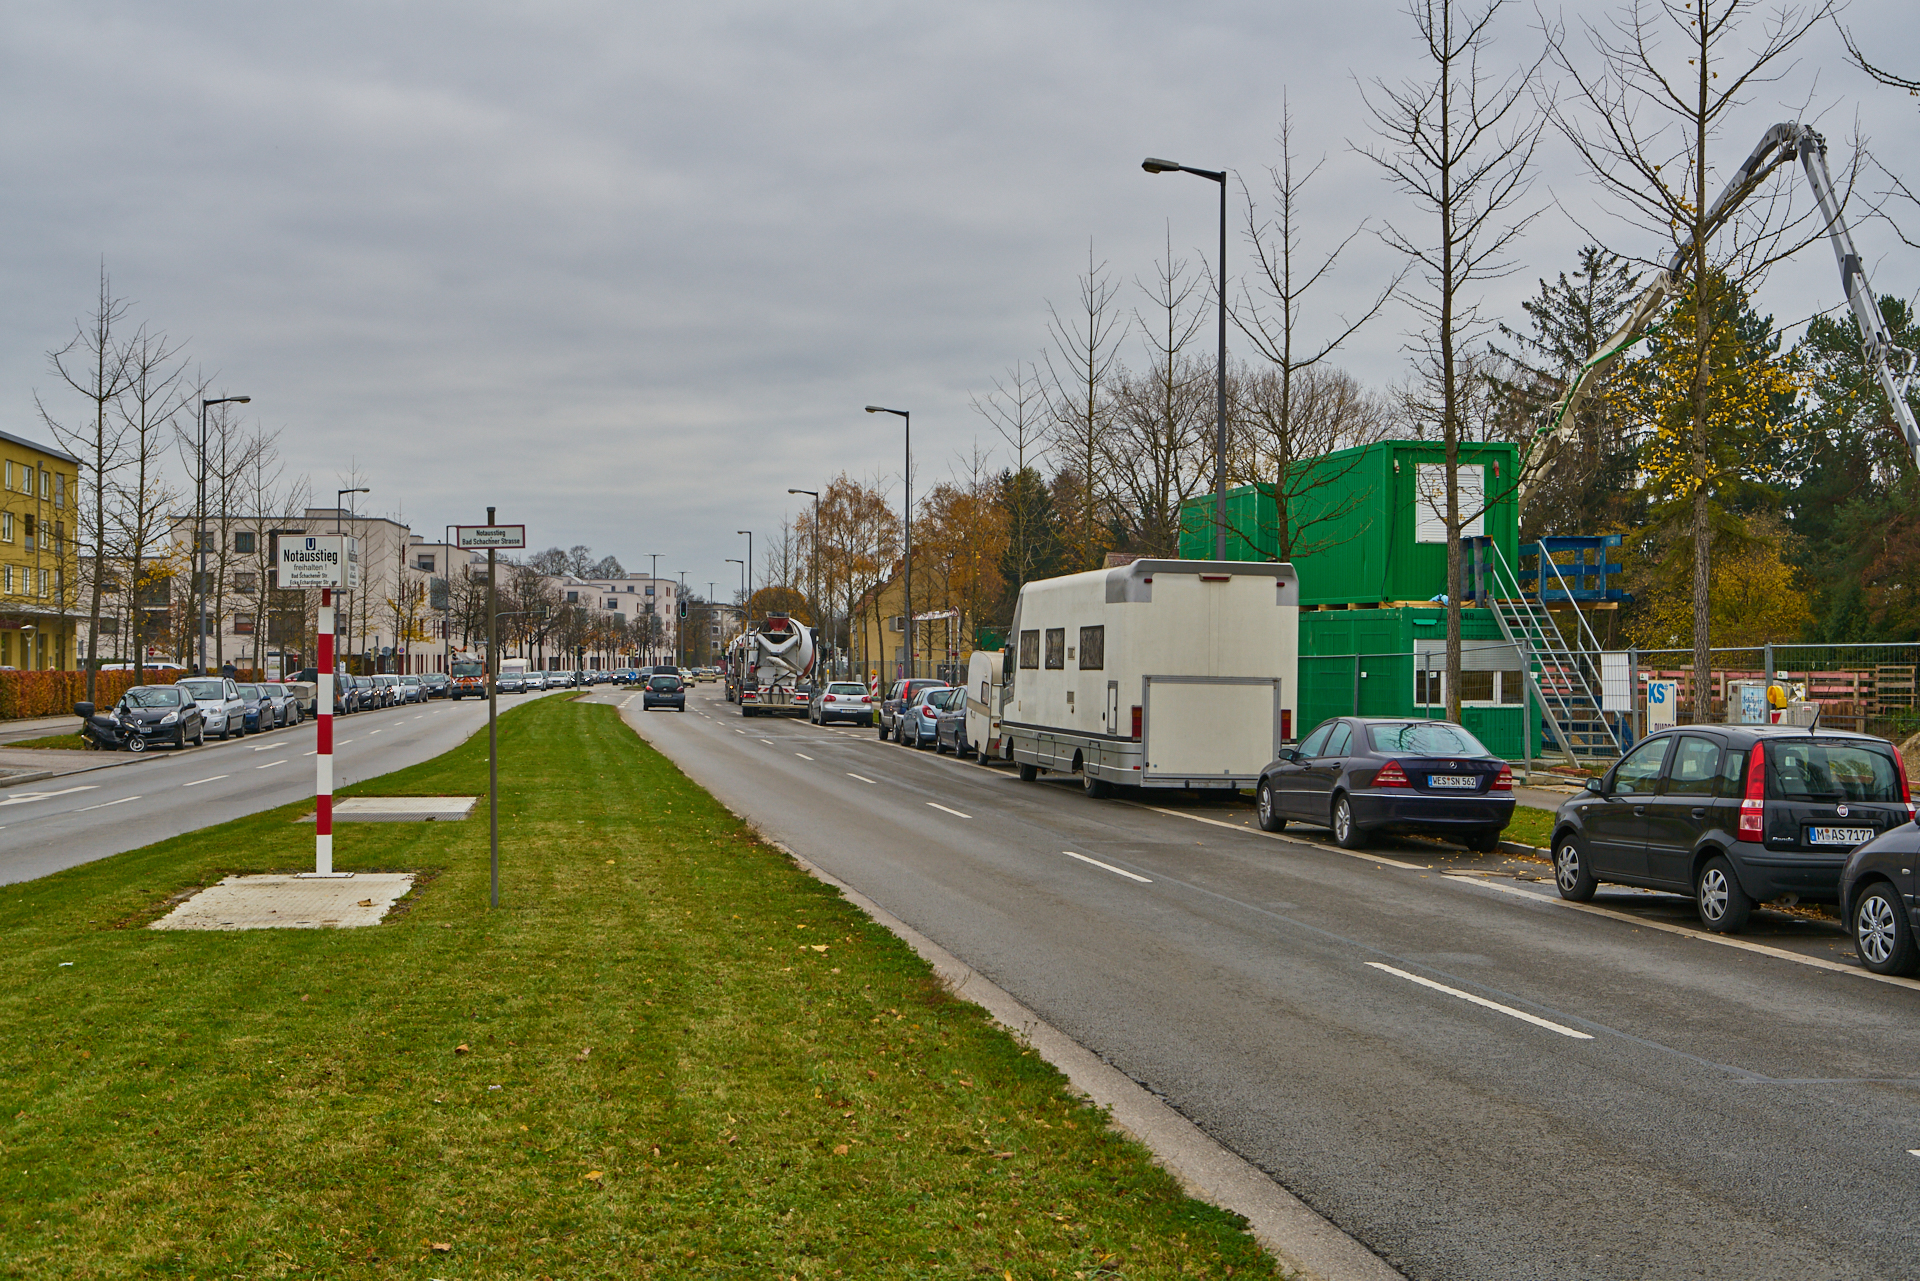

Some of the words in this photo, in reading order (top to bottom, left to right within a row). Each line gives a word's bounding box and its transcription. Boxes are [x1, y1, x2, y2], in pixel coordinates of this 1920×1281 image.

[306, 537, 315, 550] U
[283, 549, 338, 565] Notausstieg
[1648, 683, 1665, 704] KS
[1432, 776, 1447, 785] WES
[1450, 777, 1460, 785] SN
[1462, 777, 1476, 786] 562
[1816, 829, 1825, 840] M
[1831, 829, 1845, 841] AS
[1846, 829, 1873, 841] 7177
